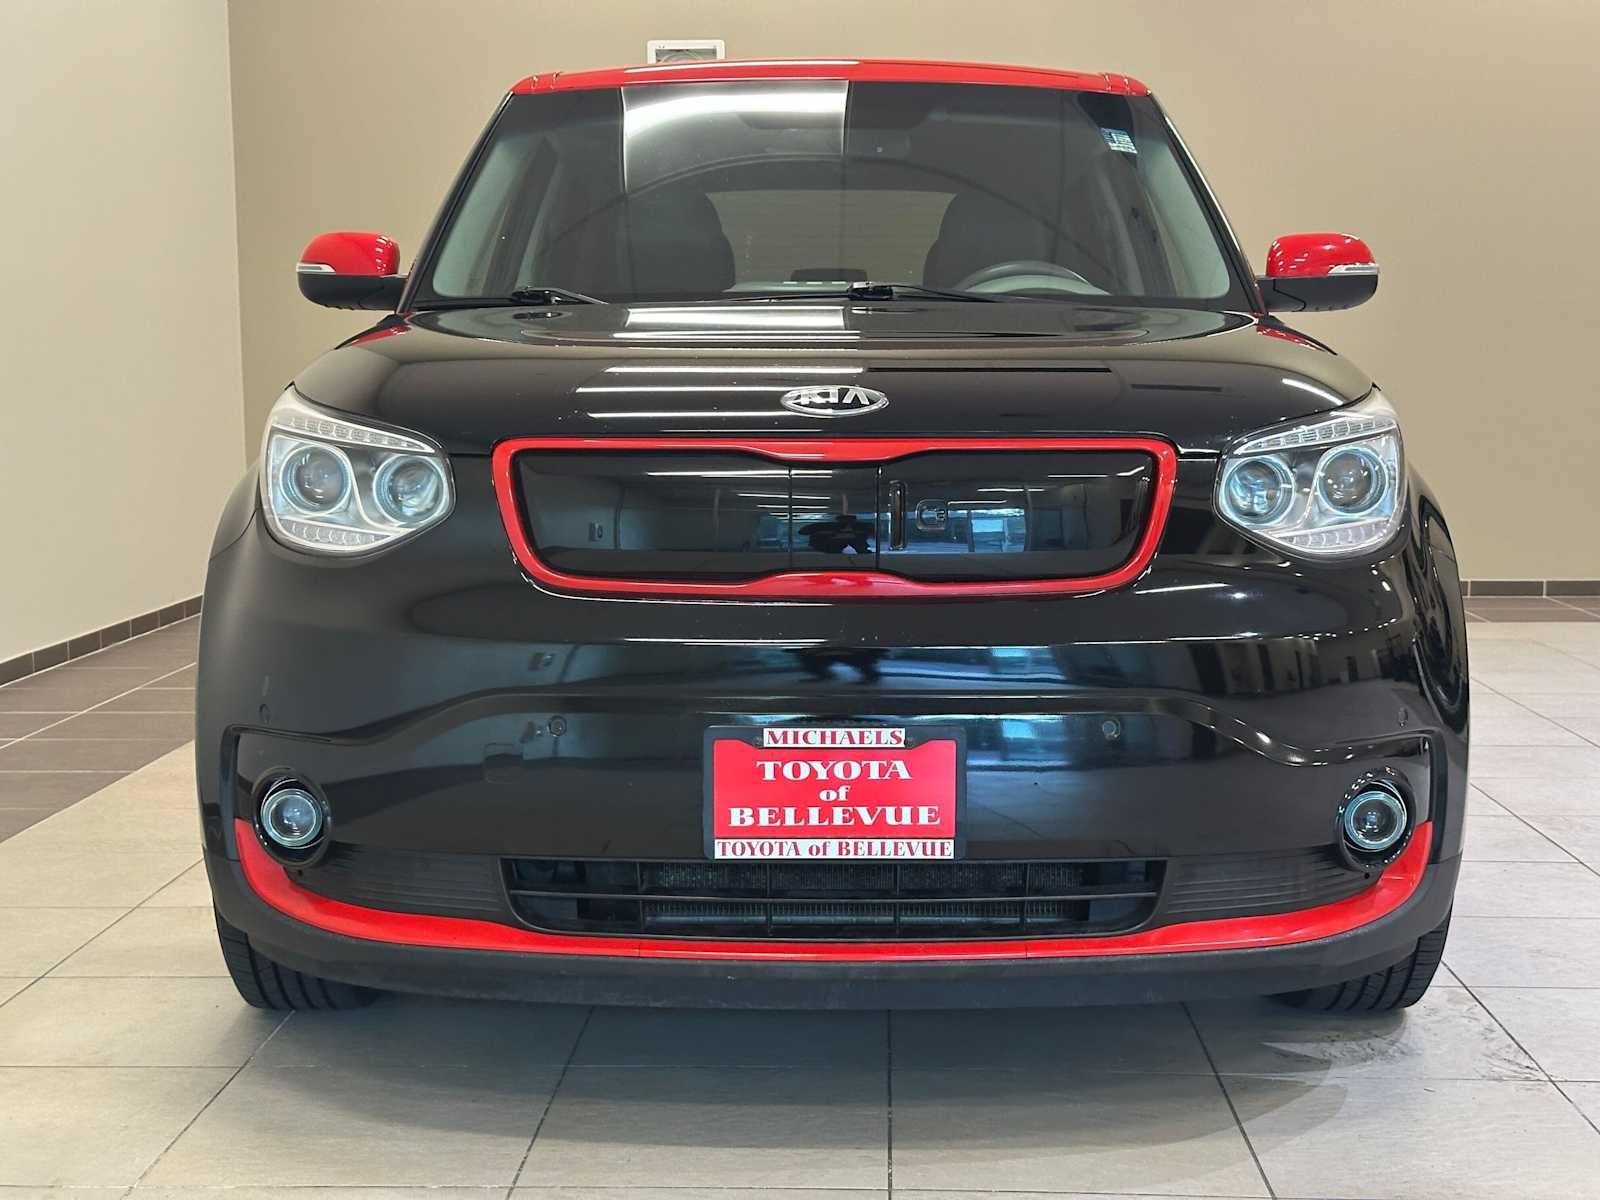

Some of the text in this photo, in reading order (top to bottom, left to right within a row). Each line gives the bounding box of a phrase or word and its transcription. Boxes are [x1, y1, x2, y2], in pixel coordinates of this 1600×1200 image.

[798, 386, 870, 405] KIA
[767, 730, 903, 745] MICHAELS
[756, 760, 912, 780] TOYOTA
[819, 785, 849, 801] of
[728, 806, 940, 827] BELLEVUE
[717, 841, 952, 857] TOYOTA of BELLEVUE
